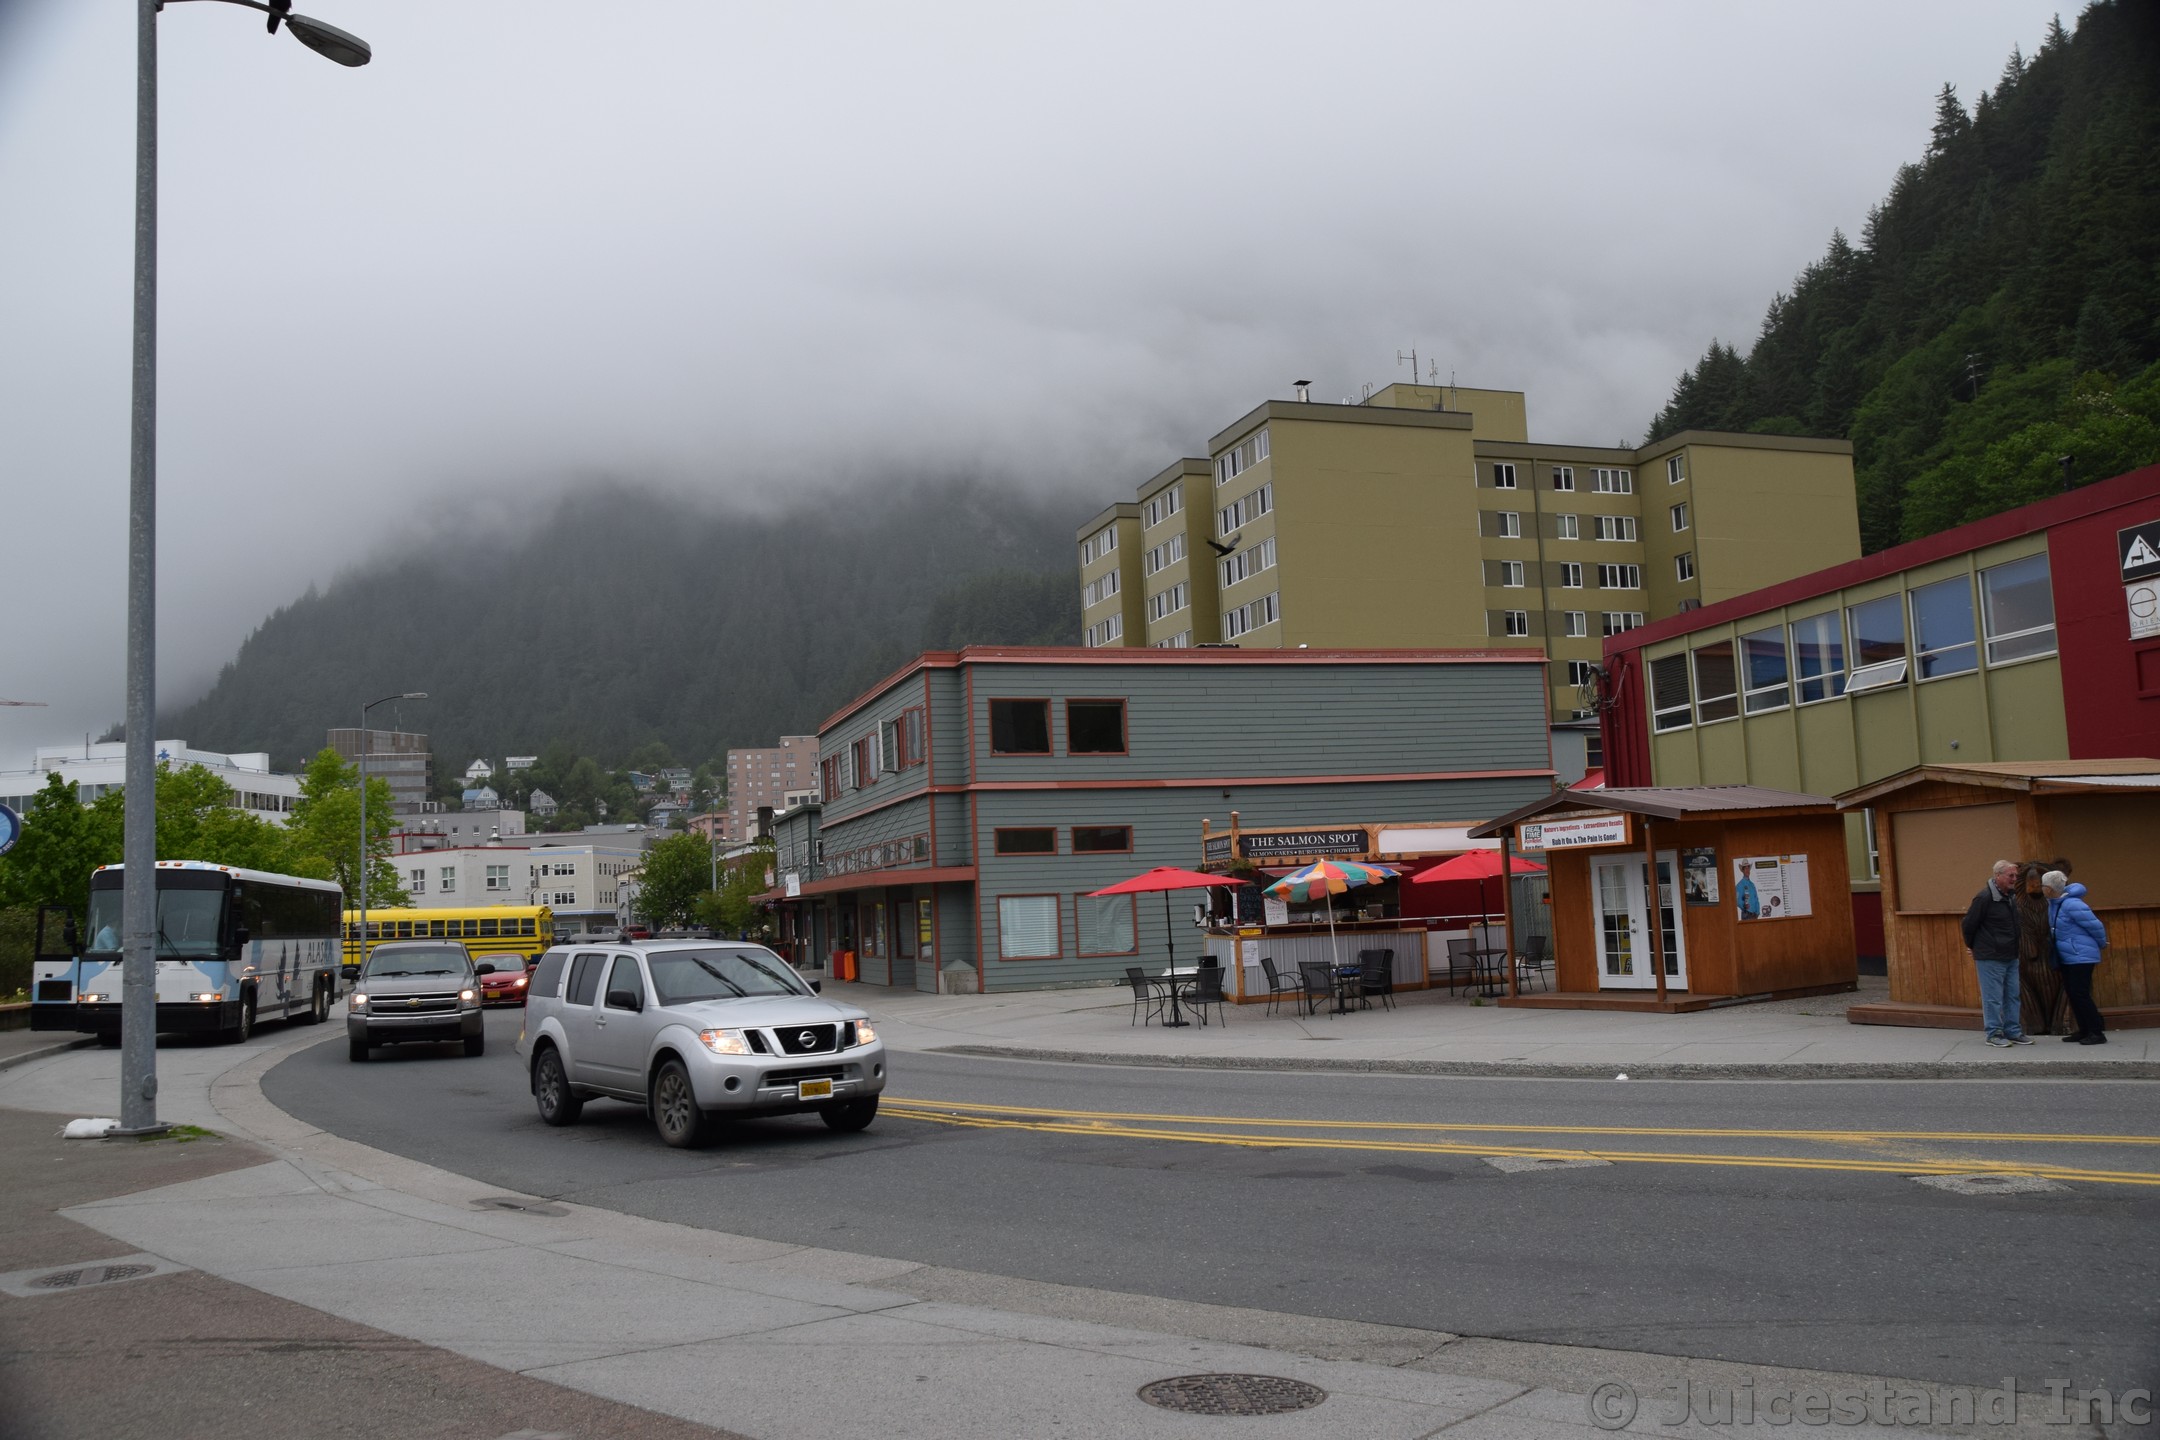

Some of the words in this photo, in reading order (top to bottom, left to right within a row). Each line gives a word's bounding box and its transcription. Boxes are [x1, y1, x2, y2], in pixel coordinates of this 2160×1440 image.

[1526, 825, 1541, 833] REAL
[1249, 837, 1275, 847] THE
[1277, 835, 1326, 846] SALMON
[1329, 833, 1358, 843] SPOT
[1578, 836, 1587, 844] The
[1587, 835, 1598, 843] Pain
[1603, 833, 1617, 841] Gone!
[1248, 850, 1274, 858] SALMON
